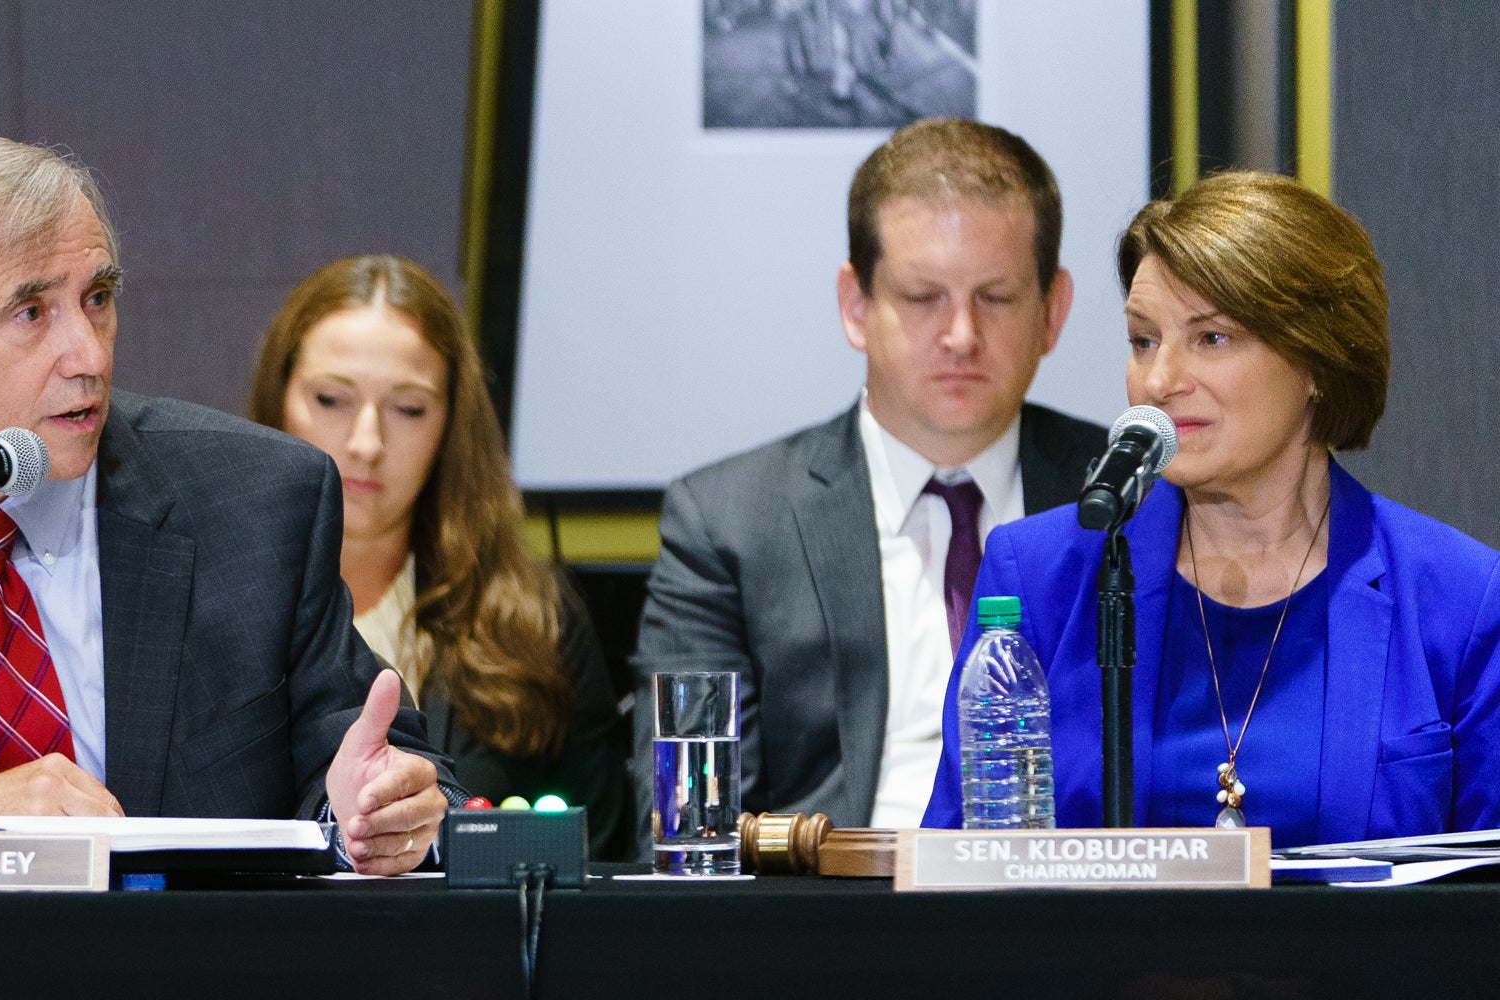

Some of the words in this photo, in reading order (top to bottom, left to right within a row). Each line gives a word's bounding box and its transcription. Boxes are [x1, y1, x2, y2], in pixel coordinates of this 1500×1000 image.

[953, 839, 1020, 862] SEN.
[1028, 838, 1210, 862] KLOBUCHAR
[1003, 862, 1158, 881] CHAIRWOMAN
